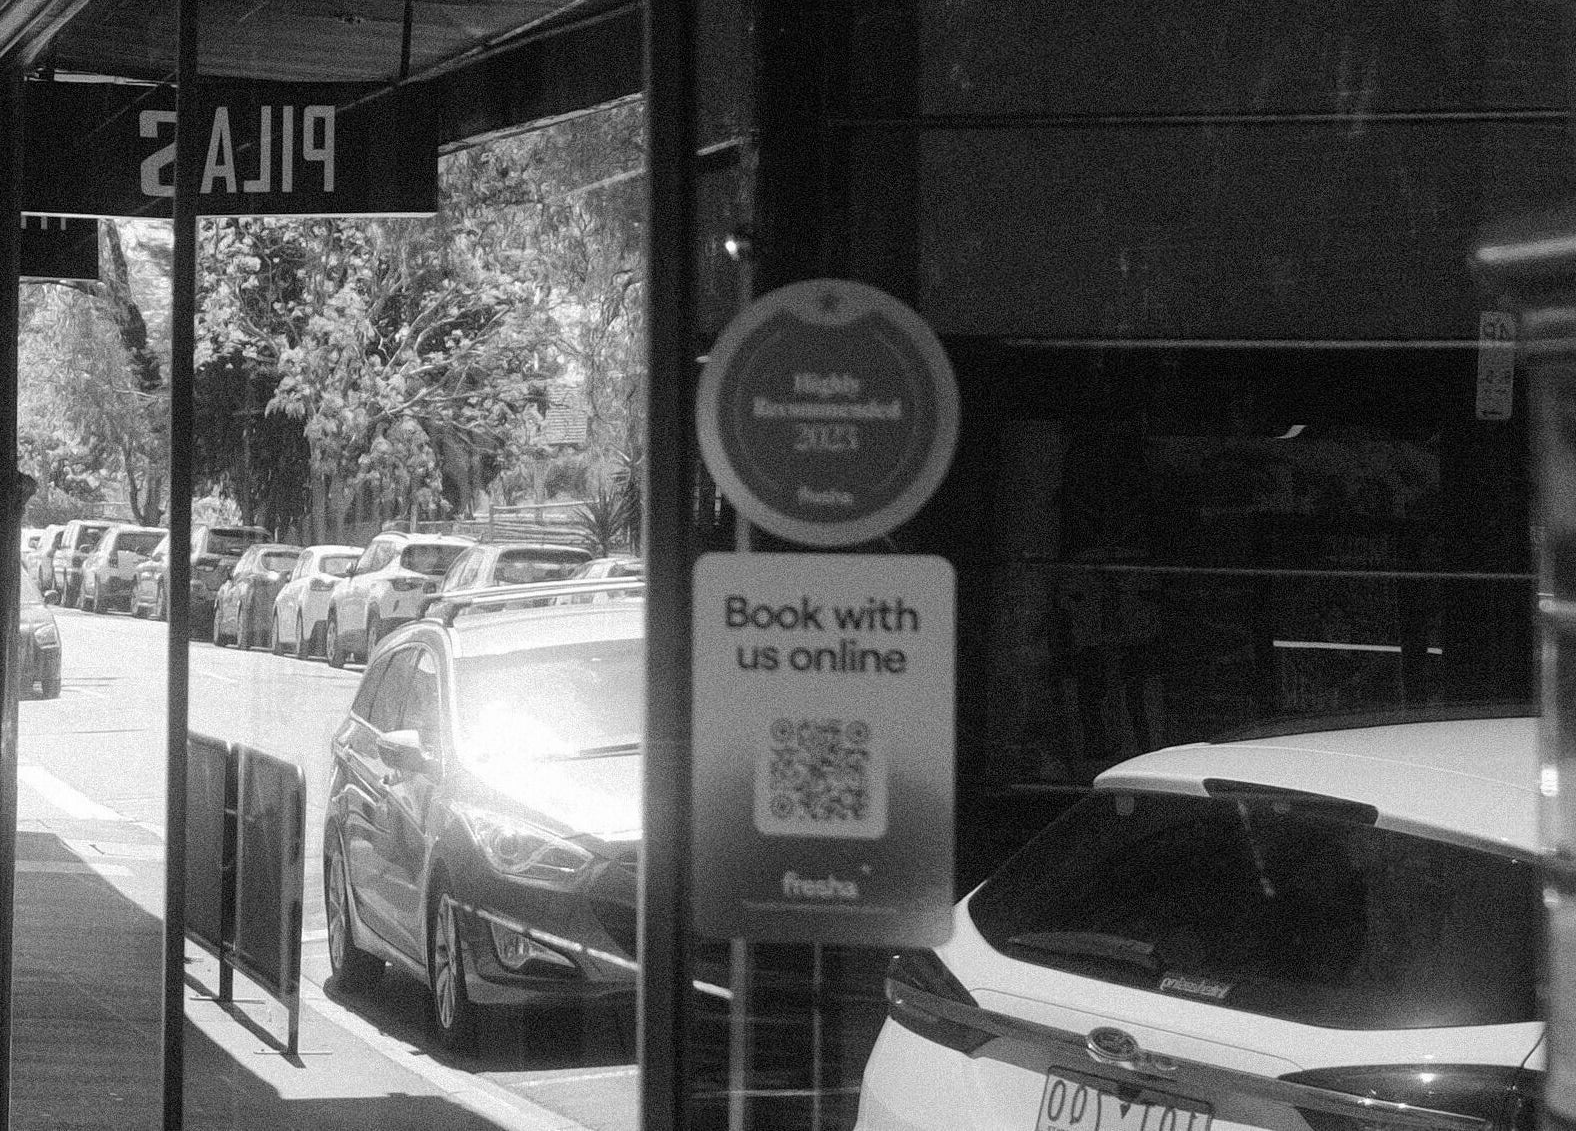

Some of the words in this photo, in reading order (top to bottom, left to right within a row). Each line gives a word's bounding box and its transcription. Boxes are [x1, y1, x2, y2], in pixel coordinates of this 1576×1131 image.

[726, 595, 825, 630] Book
[833, 596, 919, 633] with
[737, 645, 780, 670] us
[790, 638, 907, 674] online
